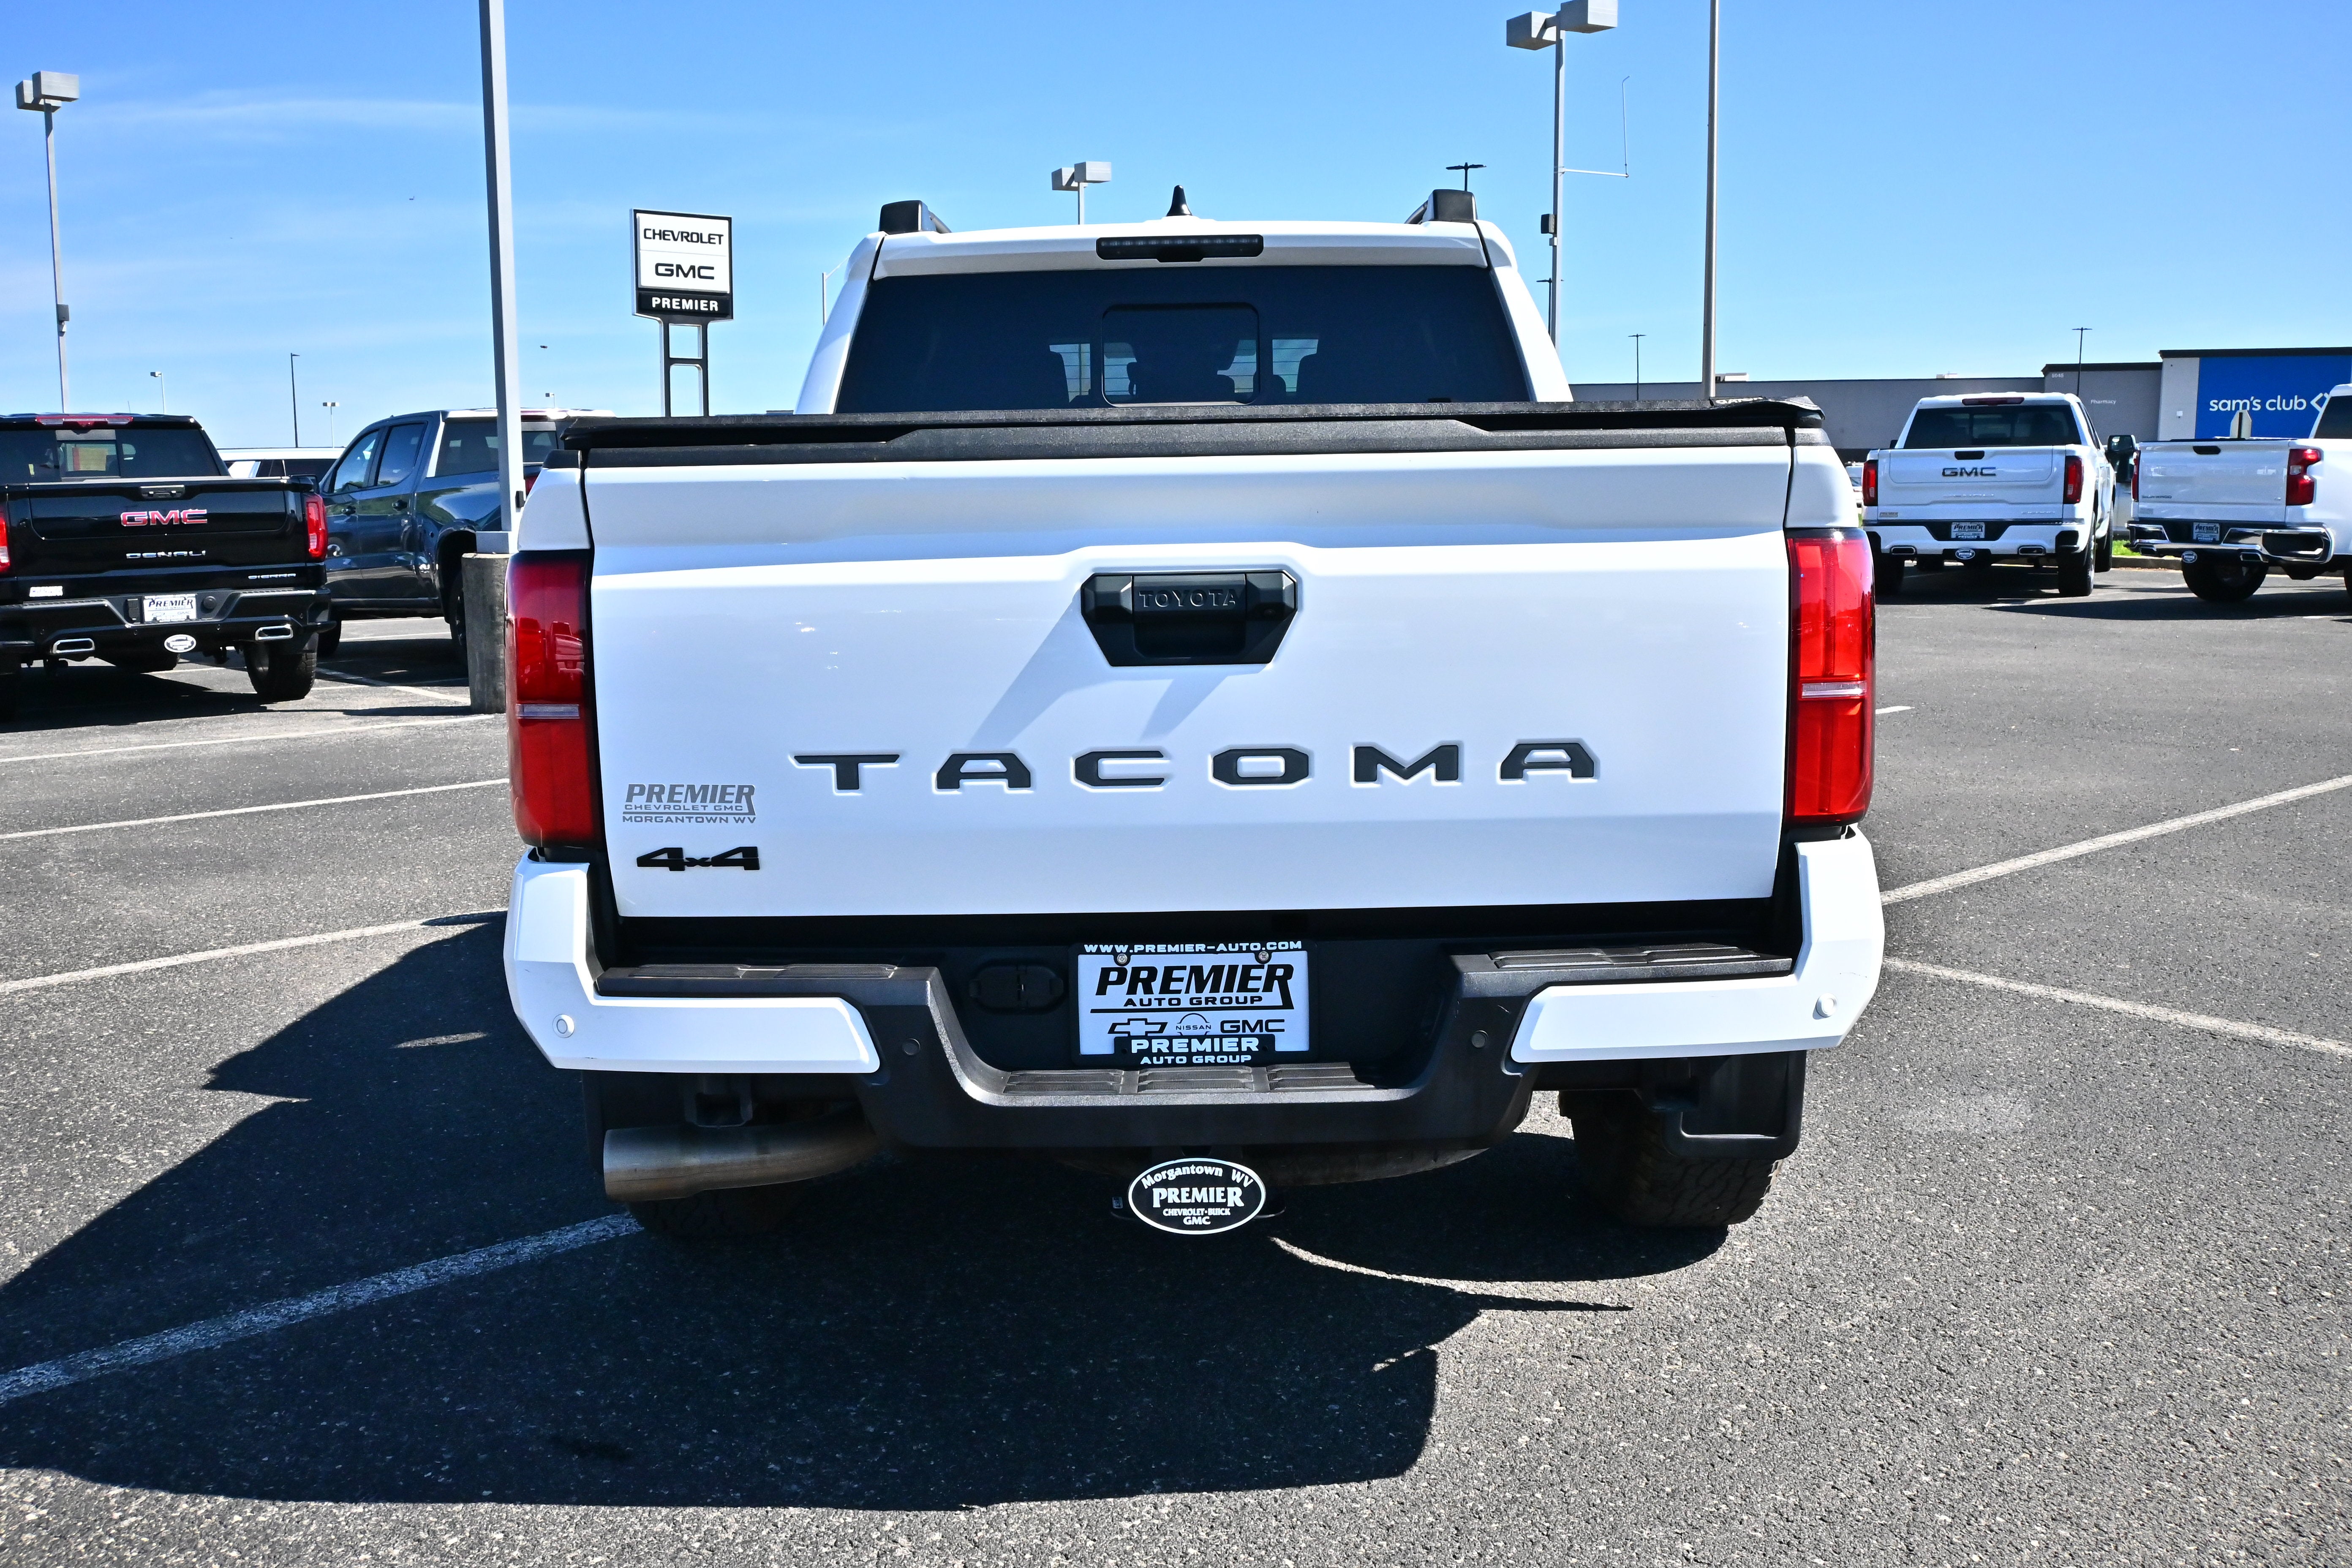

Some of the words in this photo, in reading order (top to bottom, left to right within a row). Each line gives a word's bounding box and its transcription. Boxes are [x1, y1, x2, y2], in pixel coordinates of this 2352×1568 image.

[643, 228, 724, 245] CHEVROLET
[655, 263, 714, 279] GMC
[652, 297, 718, 311] PREMIER
[2209, 396, 2261, 411] sam's
[2266, 395, 2306, 411] club
[1942, 467, 1996, 476] GMC
[120, 509, 207, 526] GMC
[149, 599, 193, 608] PREMIER
[1139, 589, 1238, 607] TOYOTA
[793, 742, 1595, 790] TACOMA
[626, 784, 756, 813] PREMIER
[637, 846, 760, 871] 4x4
[1084, 941, 1302, 953] WWW.PREMIER-AUTO.COM
[1095, 964, 1294, 1008] PREMIER
[1124, 997, 1181, 1007] AUTO
[1189, 996, 1263, 1006] GROUP
[1220, 1019, 1285, 1033] GMC
[1131, 1037, 1259, 1053] PREMIER
[1140, 1056, 1187, 1064] AUTO
[1192, 1055, 1252, 1063] GROUP
[1141, 1164, 1223, 1189] Morgantown
[1231, 1169, 1254, 1188] WV
[1152, 1187, 1244, 1208] PREMIER
[1183, 1216, 1211, 1225] GMC
